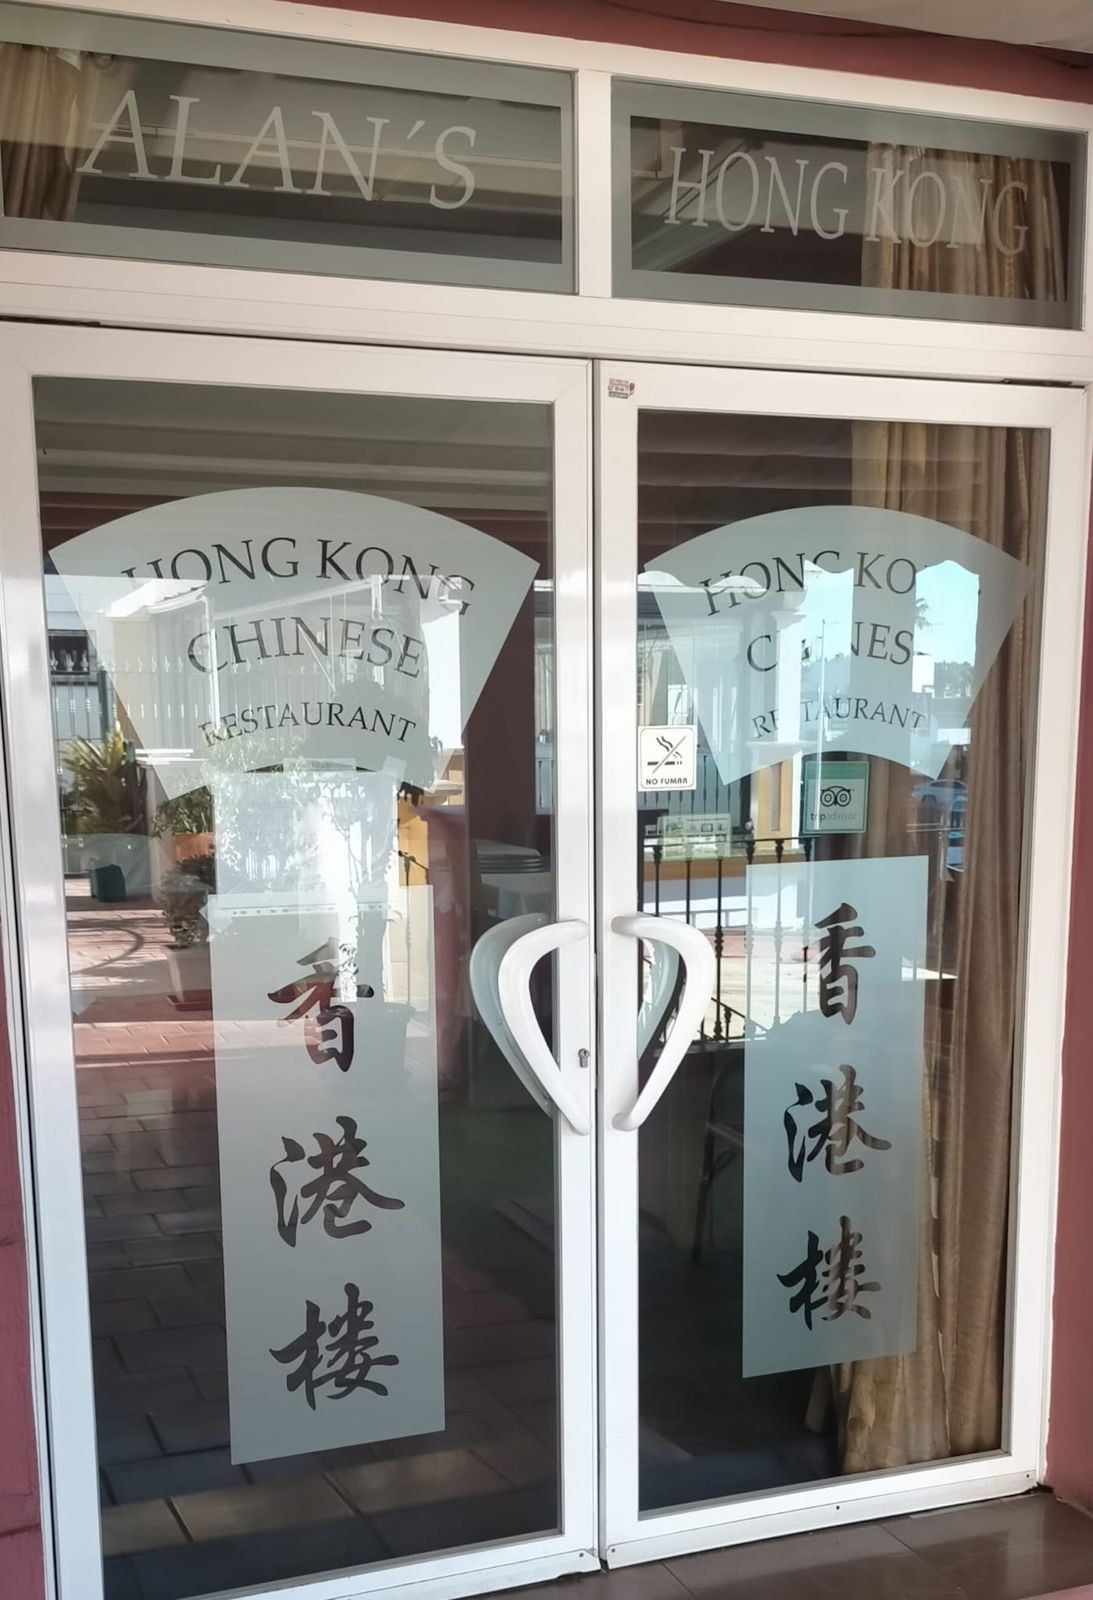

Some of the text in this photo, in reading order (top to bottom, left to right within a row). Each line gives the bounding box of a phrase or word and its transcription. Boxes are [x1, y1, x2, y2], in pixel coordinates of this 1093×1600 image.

[664, 146, 1029, 256] HONG KONG
[187, 616, 426, 679] CHINESE
[198, 701, 417, 748] RESTAURANT
[751, 697, 927, 739] RETAURANT
[645, 777, 658, 785] NO
